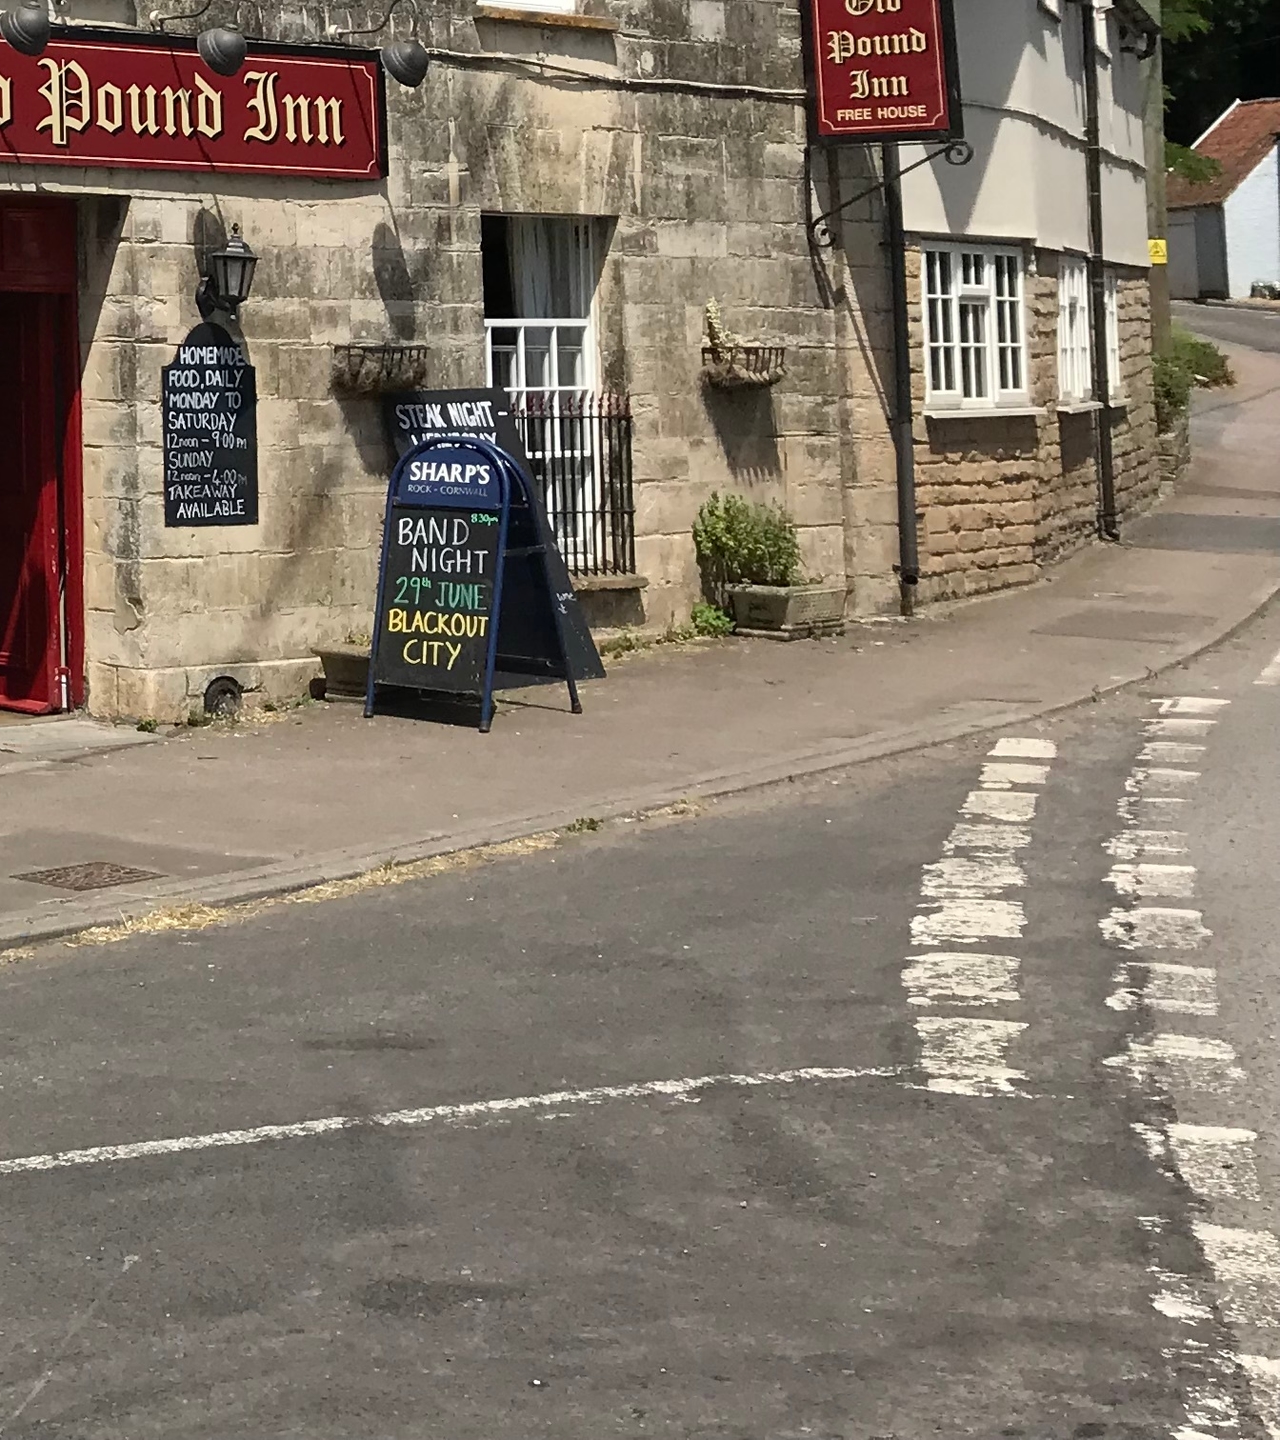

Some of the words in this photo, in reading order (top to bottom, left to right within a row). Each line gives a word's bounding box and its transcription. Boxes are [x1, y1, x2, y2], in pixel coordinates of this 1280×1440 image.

[827, 27, 926, 64] Pound
[849, 69, 909, 99] Inn
[35, 57, 223, 146] Pound
[243, 70, 346, 146] Inn
[837, 109, 872, 121] FREE
[878, 105, 927, 119] HOUSE
[179, 346, 245, 365] HOMEMADE
[225, 391, 241, 408] TO
[168, 411, 237, 432] SATURDAY
[395, 403, 447, 429] STEAK
[447, 401, 494, 427] NIGHT
[169, 450, 214, 469] SUNDAY
[409, 462, 490, 484] SHARP'S
[169, 484, 238, 501] TAKEAWAY
[407, 484, 432, 493] ROCK
[440, 485, 488, 497] CORNWALL
[176, 499, 245, 519] AVAILABLE
[398, 517, 469, 546] BAND
[411, 547, 489, 574] NIGHT
[394, 576, 432, 605] 29th
[435, 580, 487, 611] JUNE
[388, 608, 489, 637] BLACKOUT
[403, 639, 461, 671] CITY
